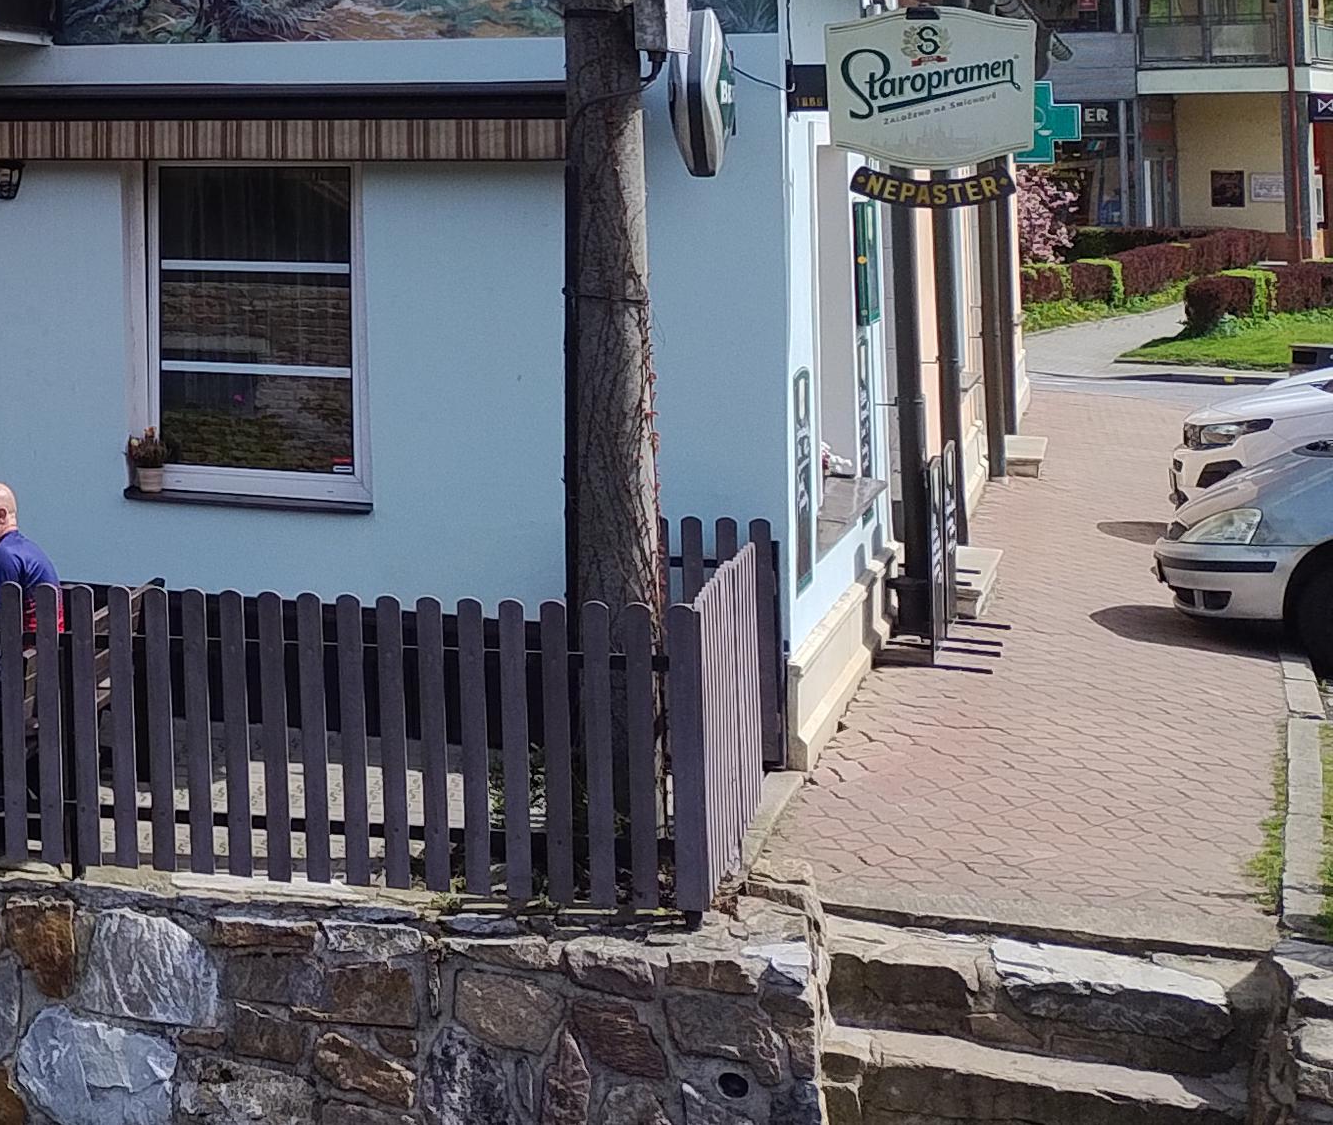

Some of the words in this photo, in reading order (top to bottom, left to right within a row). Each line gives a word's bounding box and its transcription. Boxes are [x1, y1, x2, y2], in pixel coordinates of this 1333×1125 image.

[840, 48, 1023, 119] Staropramen
[1084, 107, 1109, 122] ER
[865, 174, 1000, 205] NEPASTER
